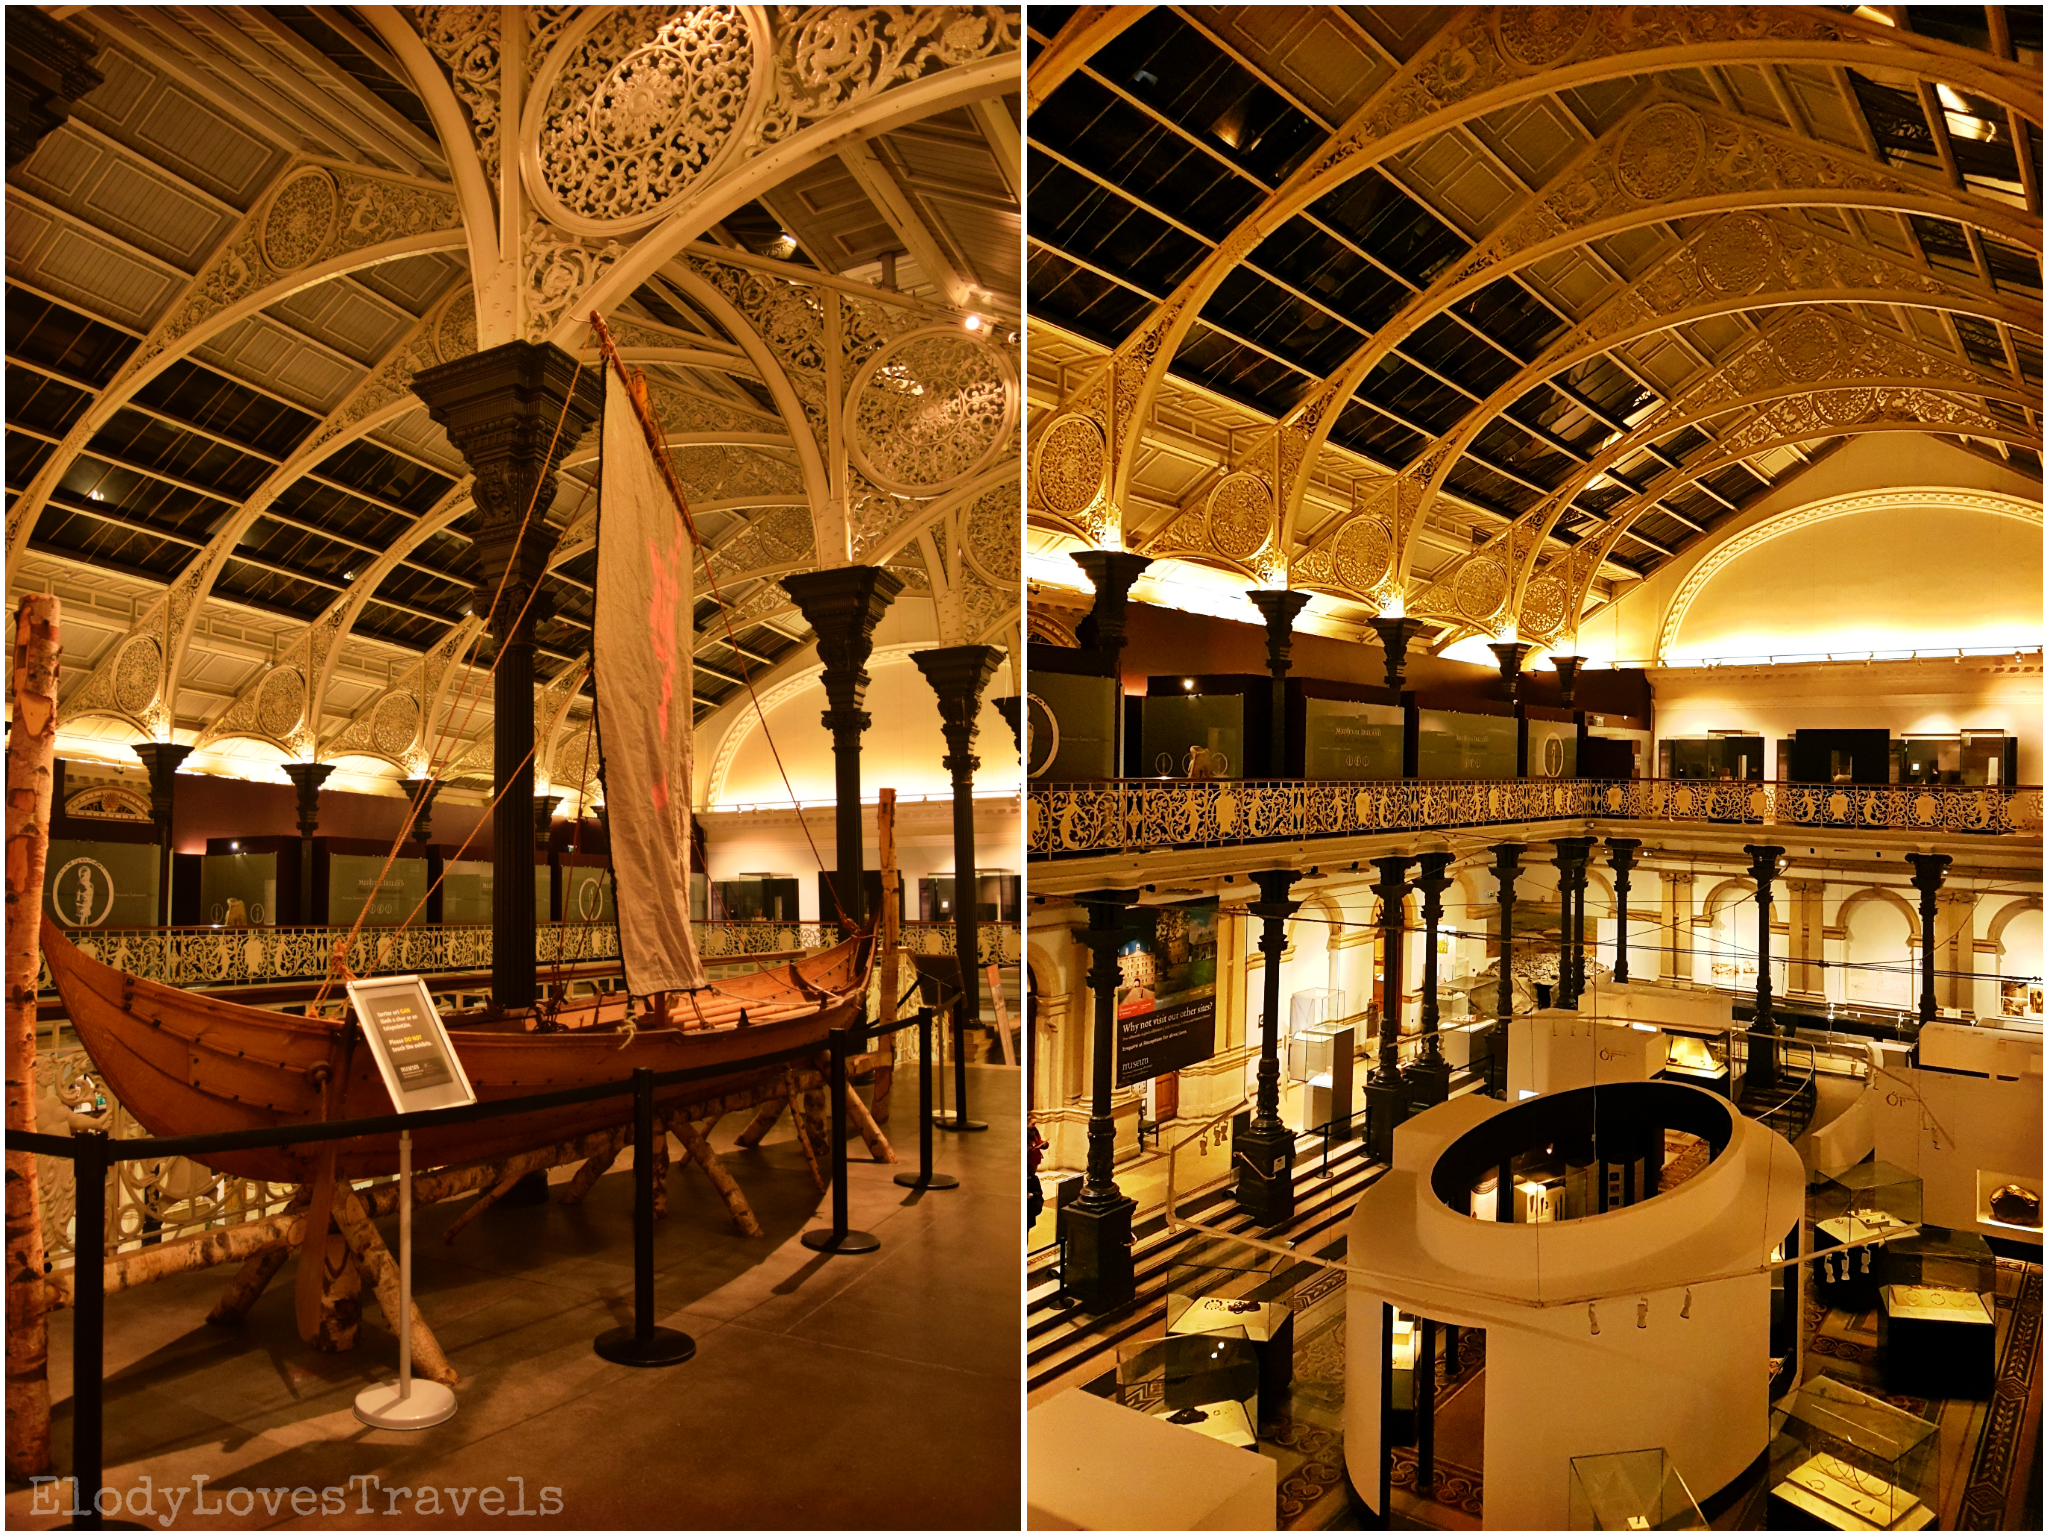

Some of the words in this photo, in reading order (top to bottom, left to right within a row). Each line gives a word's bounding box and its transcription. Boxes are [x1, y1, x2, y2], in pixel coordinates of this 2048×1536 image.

[1123, 1022, 1140, 1033] Why
[1140, 1019, 1152, 1029] not
[1152, 1014, 1167, 1026] visit
[1167, 1013, 1179, 1022] our
[1179, 1006, 1197, 1018] other
[1197, 1001, 1213, 1013] sites?
[1143, 1036, 1163, 1047] Reception
[1122, 1057, 1149, 1071] museum
